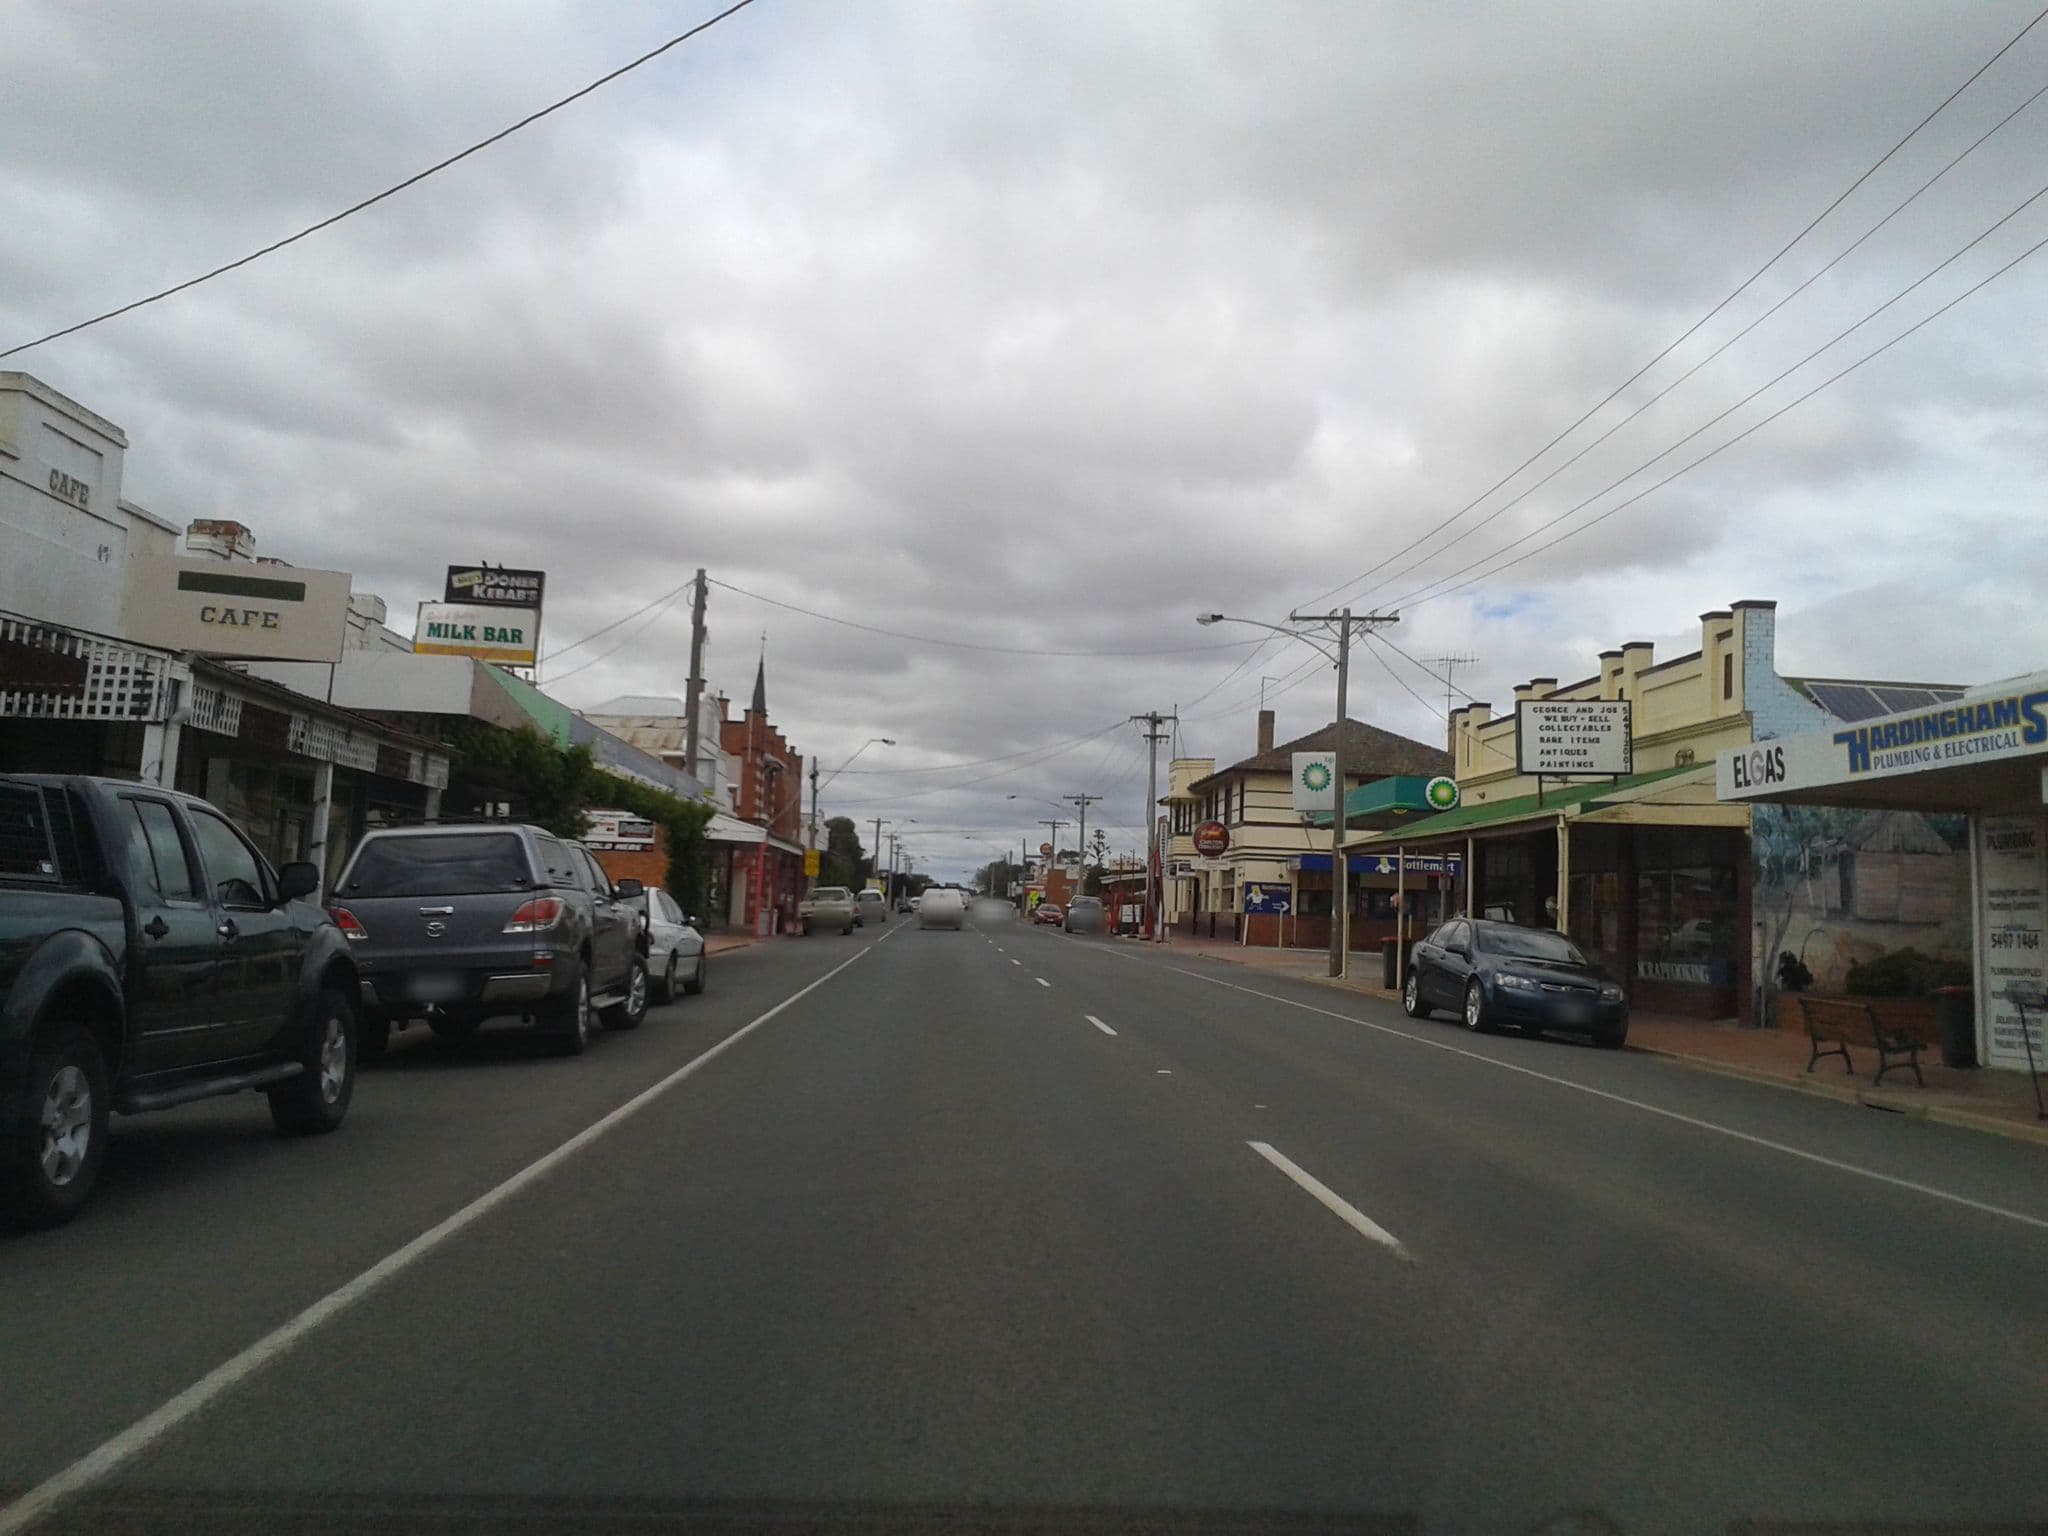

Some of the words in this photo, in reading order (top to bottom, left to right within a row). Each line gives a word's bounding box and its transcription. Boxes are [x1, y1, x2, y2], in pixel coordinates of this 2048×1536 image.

[50, 469, 89, 504] CAFE
[484, 571, 539, 588] DONER
[200, 606, 280, 629] CAFE
[427, 622, 476, 640] MILK
[483, 626, 523, 643] BAR
[1544, 715, 1558, 723] WE
[1588, 715, 1610, 723] SELL
[1576, 706, 1594, 714] AND
[1539, 724, 1612, 732] COLLECTABLES
[1833, 690, 2048, 773] HARDINGHAMS
[1570, 735, 1600, 744] ITEMS
[1540, 748, 1588, 756] ANTIQUES
[1873, 743, 1931, 771] PLUMBING
[1933, 744, 1942, 760] &
[1945, 730, 2019, 758] ELECTRICAL
[1733, 746, 1786, 788] ELGAS
